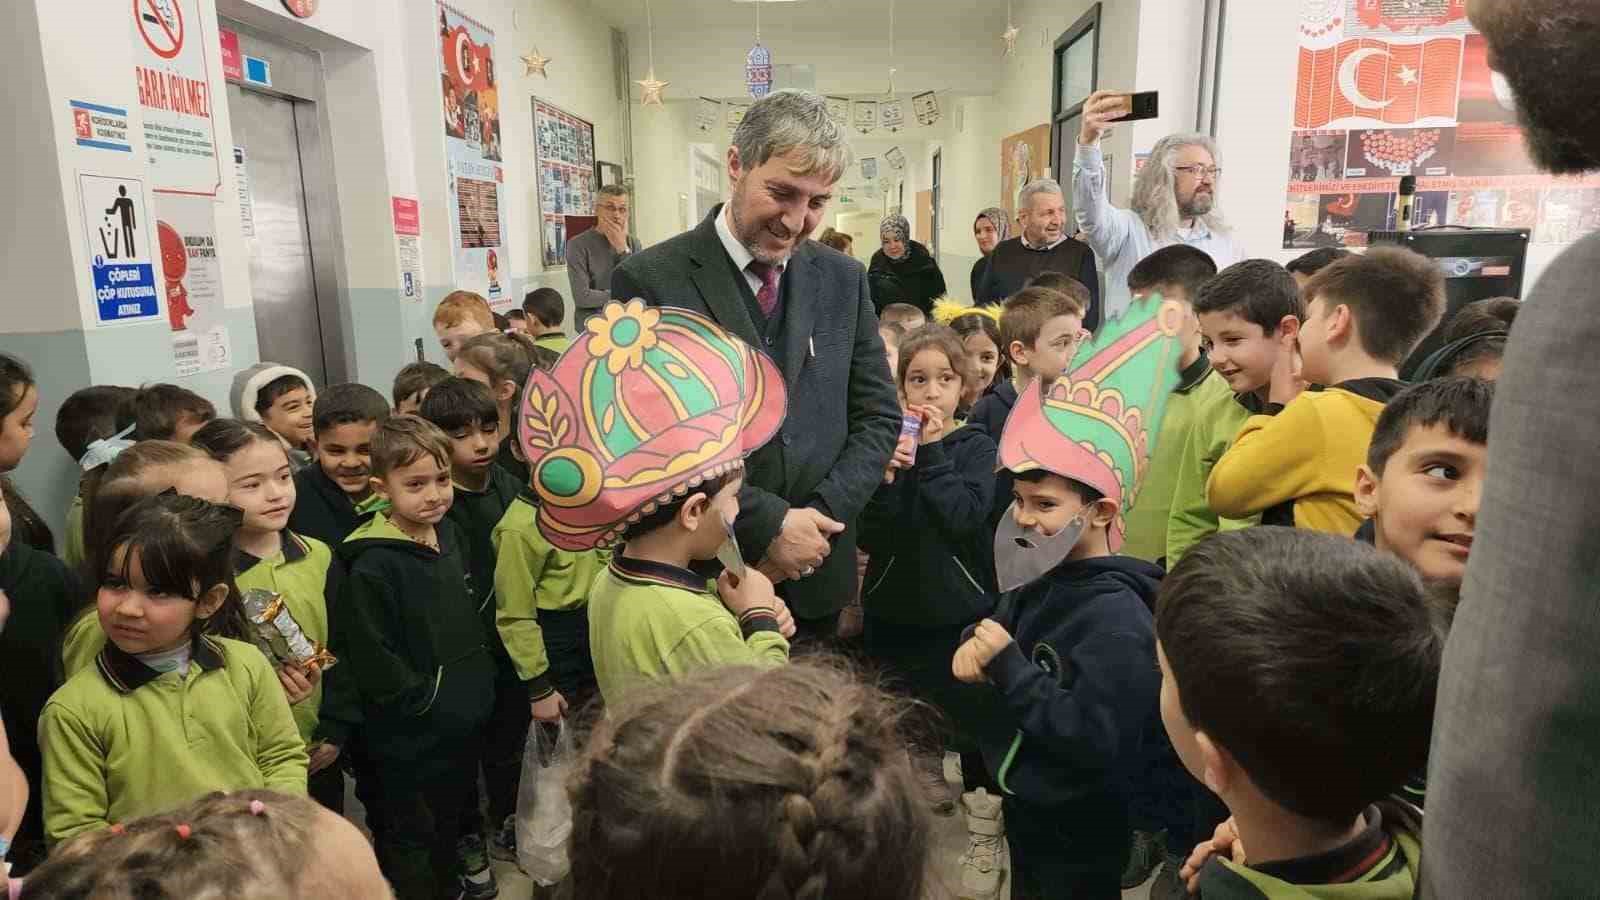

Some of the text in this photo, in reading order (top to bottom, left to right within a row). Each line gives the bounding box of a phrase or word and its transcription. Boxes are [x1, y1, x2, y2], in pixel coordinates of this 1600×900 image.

[168, 68, 209, 118] İÇİLMEZ
[108, 267, 141, 285] ÇÖPLERİ
[97, 285, 155, 304] ÇÖP KUTUSUNA
